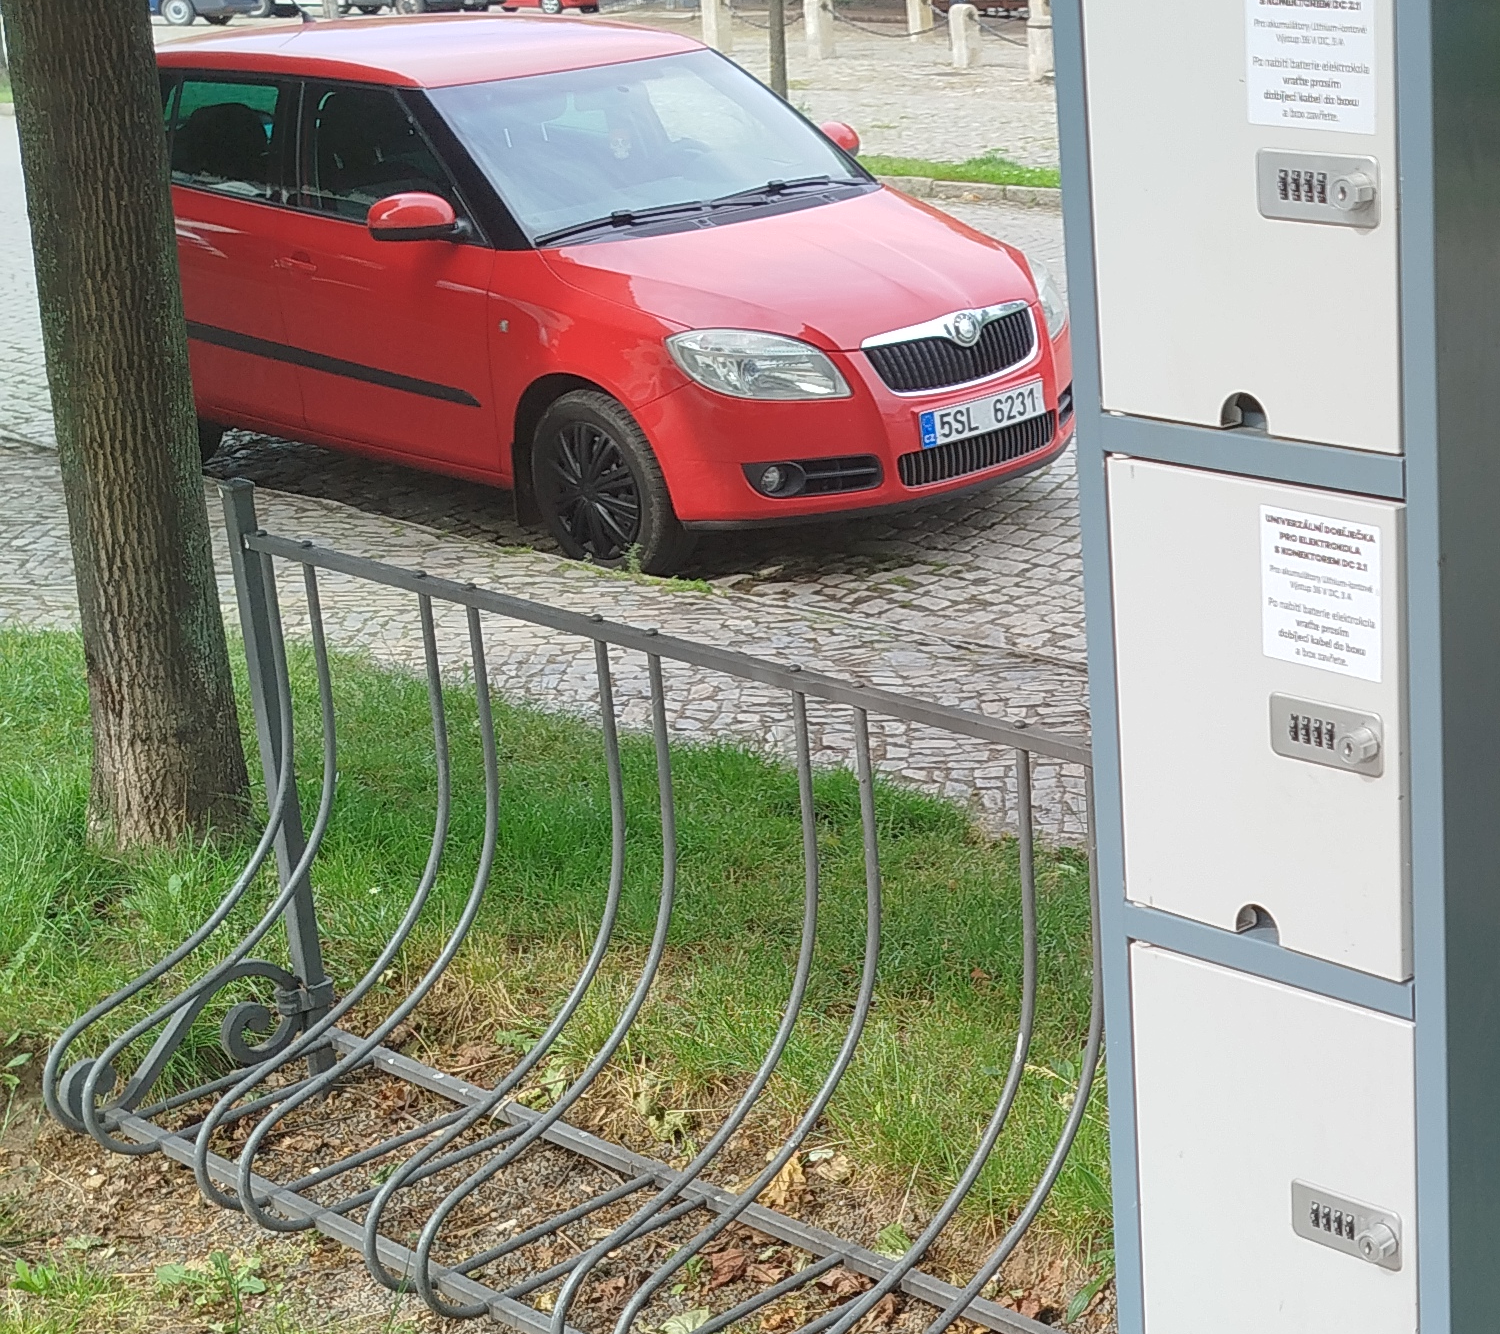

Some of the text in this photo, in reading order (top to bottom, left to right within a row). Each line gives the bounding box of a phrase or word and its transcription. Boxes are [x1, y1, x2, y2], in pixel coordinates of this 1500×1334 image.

[939, 387, 1038, 439] 5SL 6231
[1279, 531, 1298, 542] PRO
